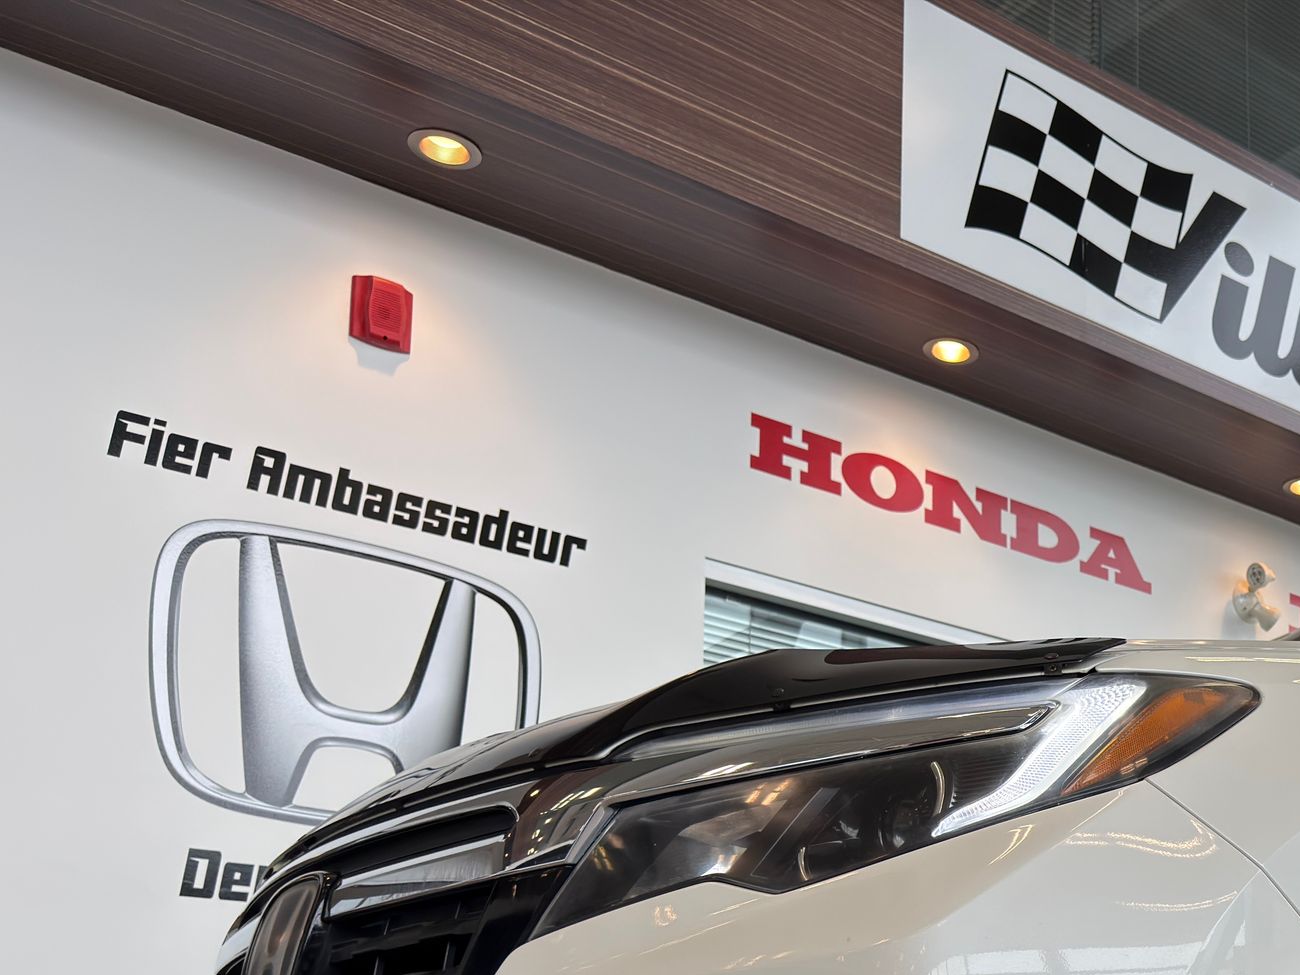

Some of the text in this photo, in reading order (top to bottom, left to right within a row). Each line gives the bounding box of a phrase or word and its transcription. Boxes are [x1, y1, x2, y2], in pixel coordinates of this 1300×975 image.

[106, 410, 588, 567] Fier Ambassadeur
[750, 412, 1153, 595] HONDA
